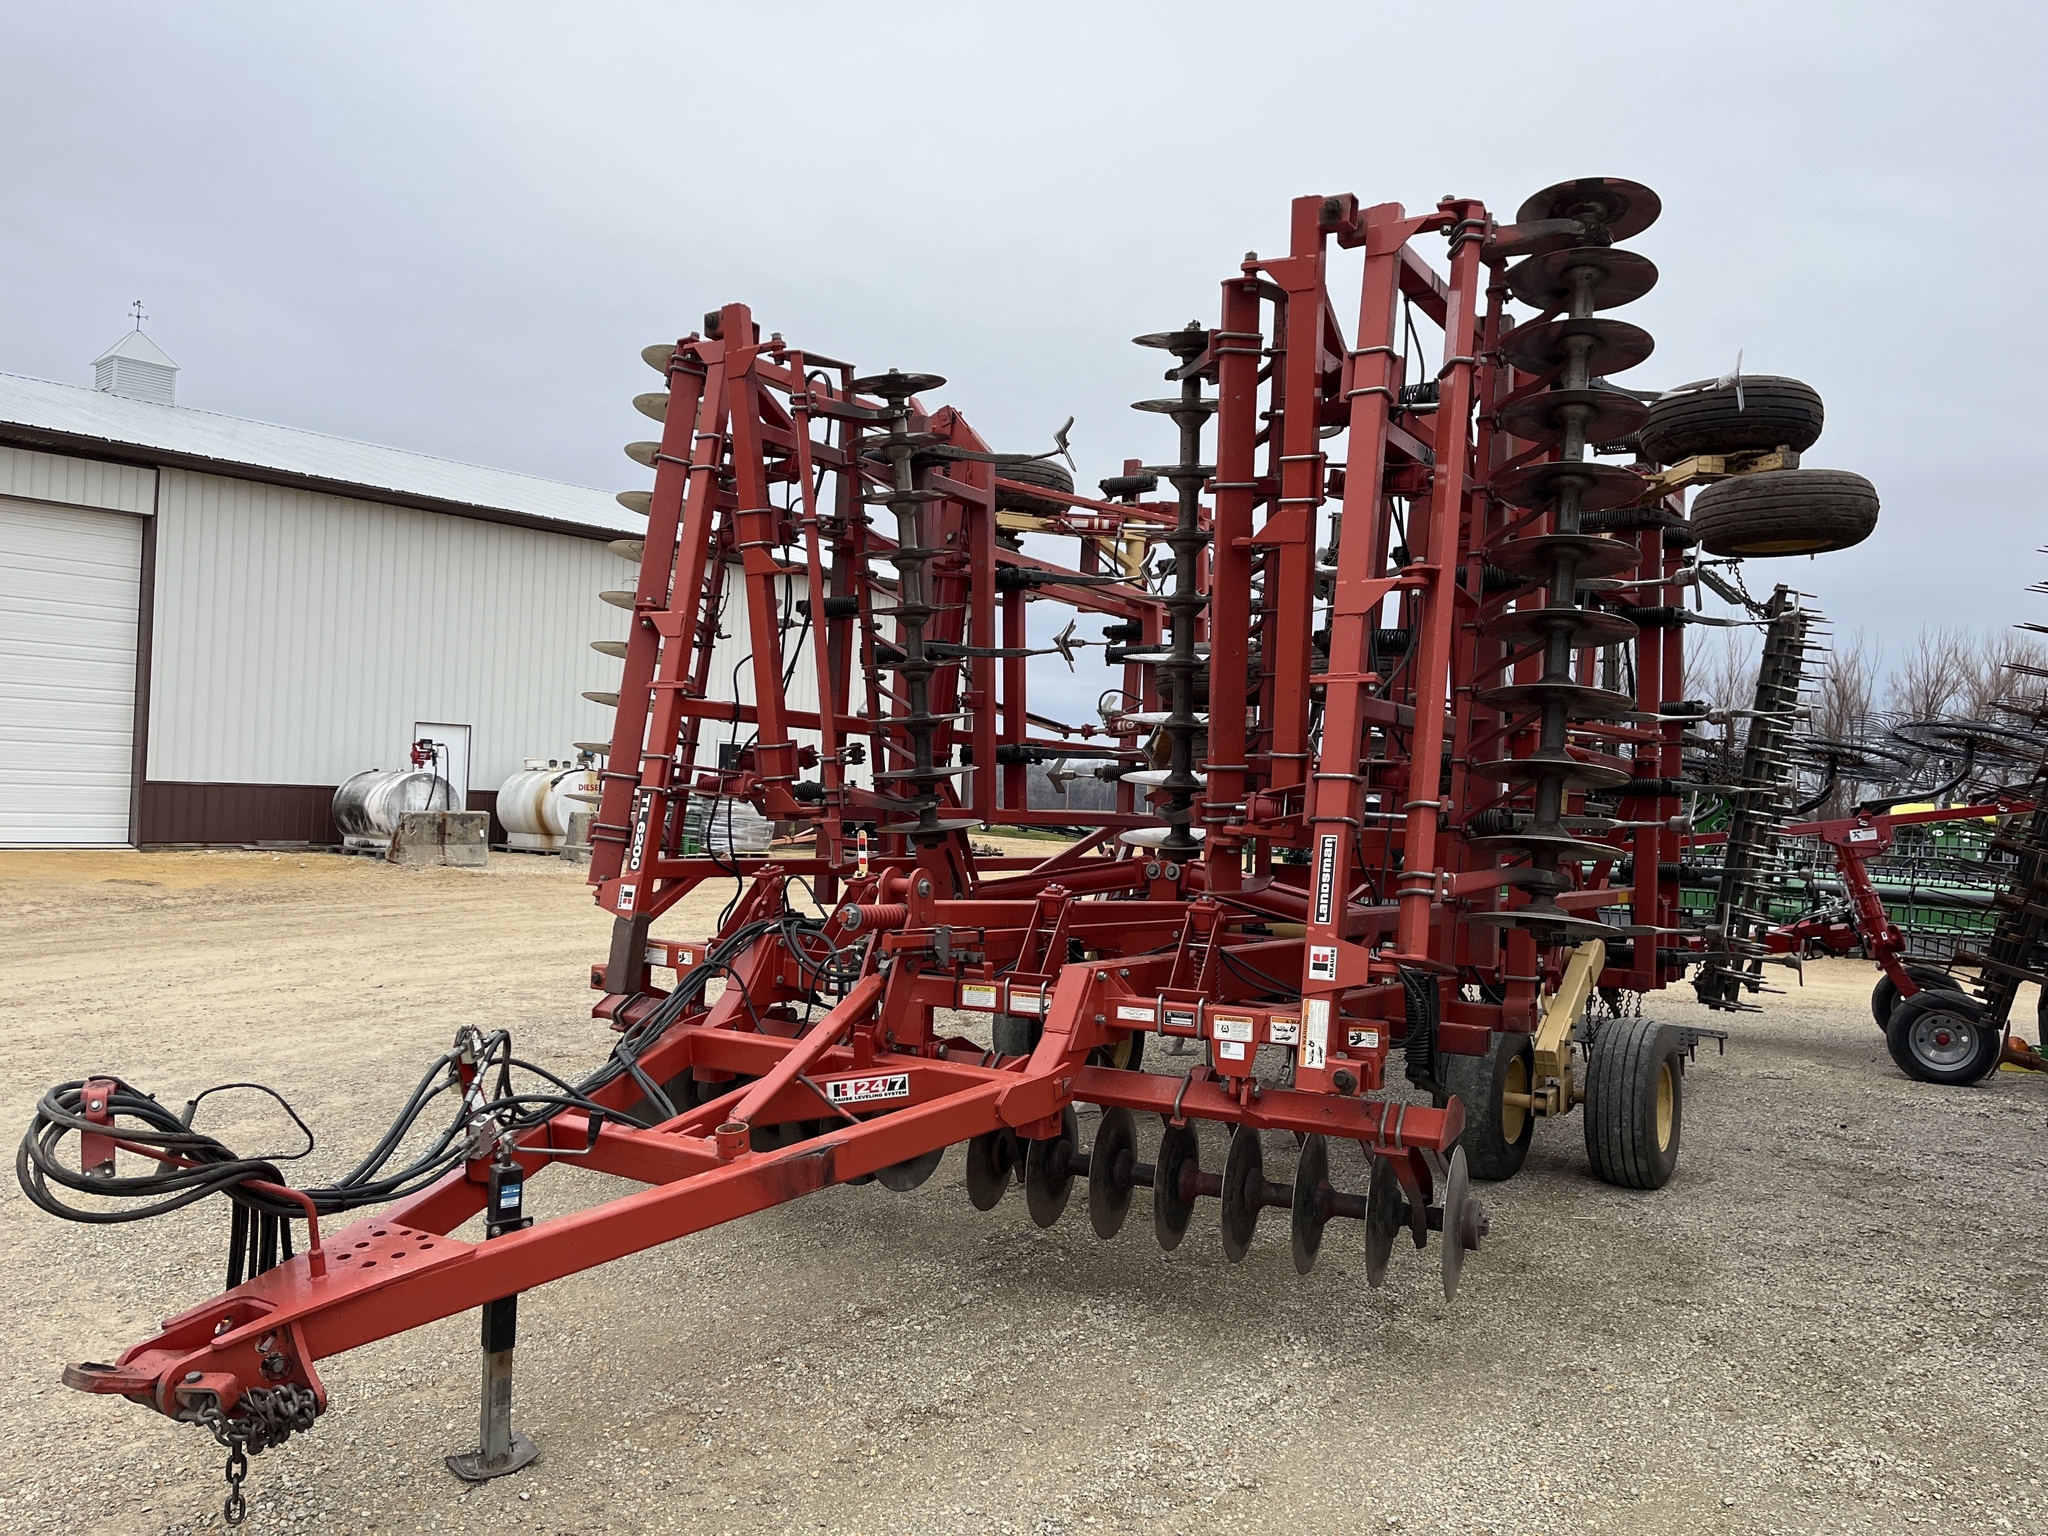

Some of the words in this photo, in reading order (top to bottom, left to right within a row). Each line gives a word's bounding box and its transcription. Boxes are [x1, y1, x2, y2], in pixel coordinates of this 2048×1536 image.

[638, 793, 651, 819] TL
[630, 821, 646, 870] 6200
[854, 1092, 883, 1100] LEVELING
